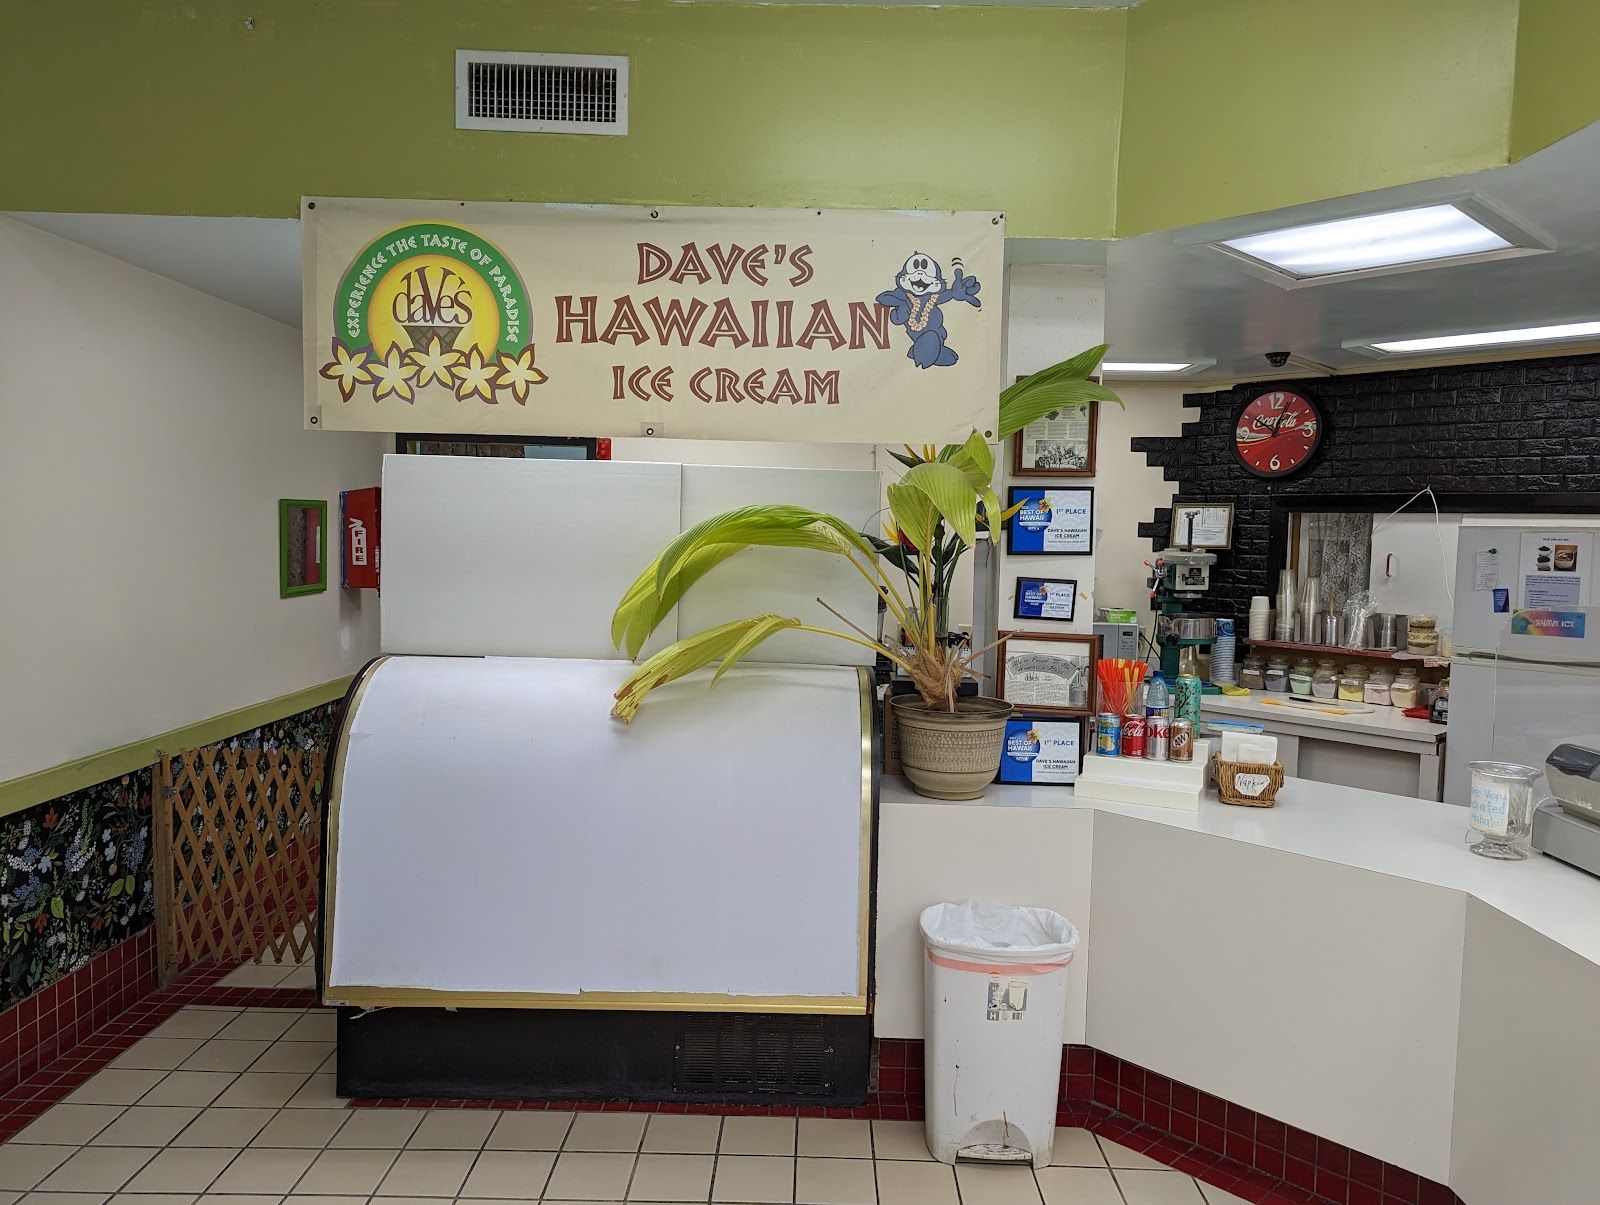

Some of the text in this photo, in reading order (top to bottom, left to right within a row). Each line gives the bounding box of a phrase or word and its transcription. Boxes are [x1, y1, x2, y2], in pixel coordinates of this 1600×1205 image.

[637, 242, 815, 287] DAVE'S
[347, 234, 520, 343] EXPERIENCE THE TASTE OF PARADISE
[554, 294, 892, 350] HAWAIIAN
[612, 365, 840, 405] ICE CREAM
[1268, 392, 1285, 410] 12
[1240, 422, 1313, 441] 9 3
[1270, 455, 1280, 470] 6
[355, 530, 364, 562] FIRE
[1535, 618, 1576, 628] SHAVE ICE
